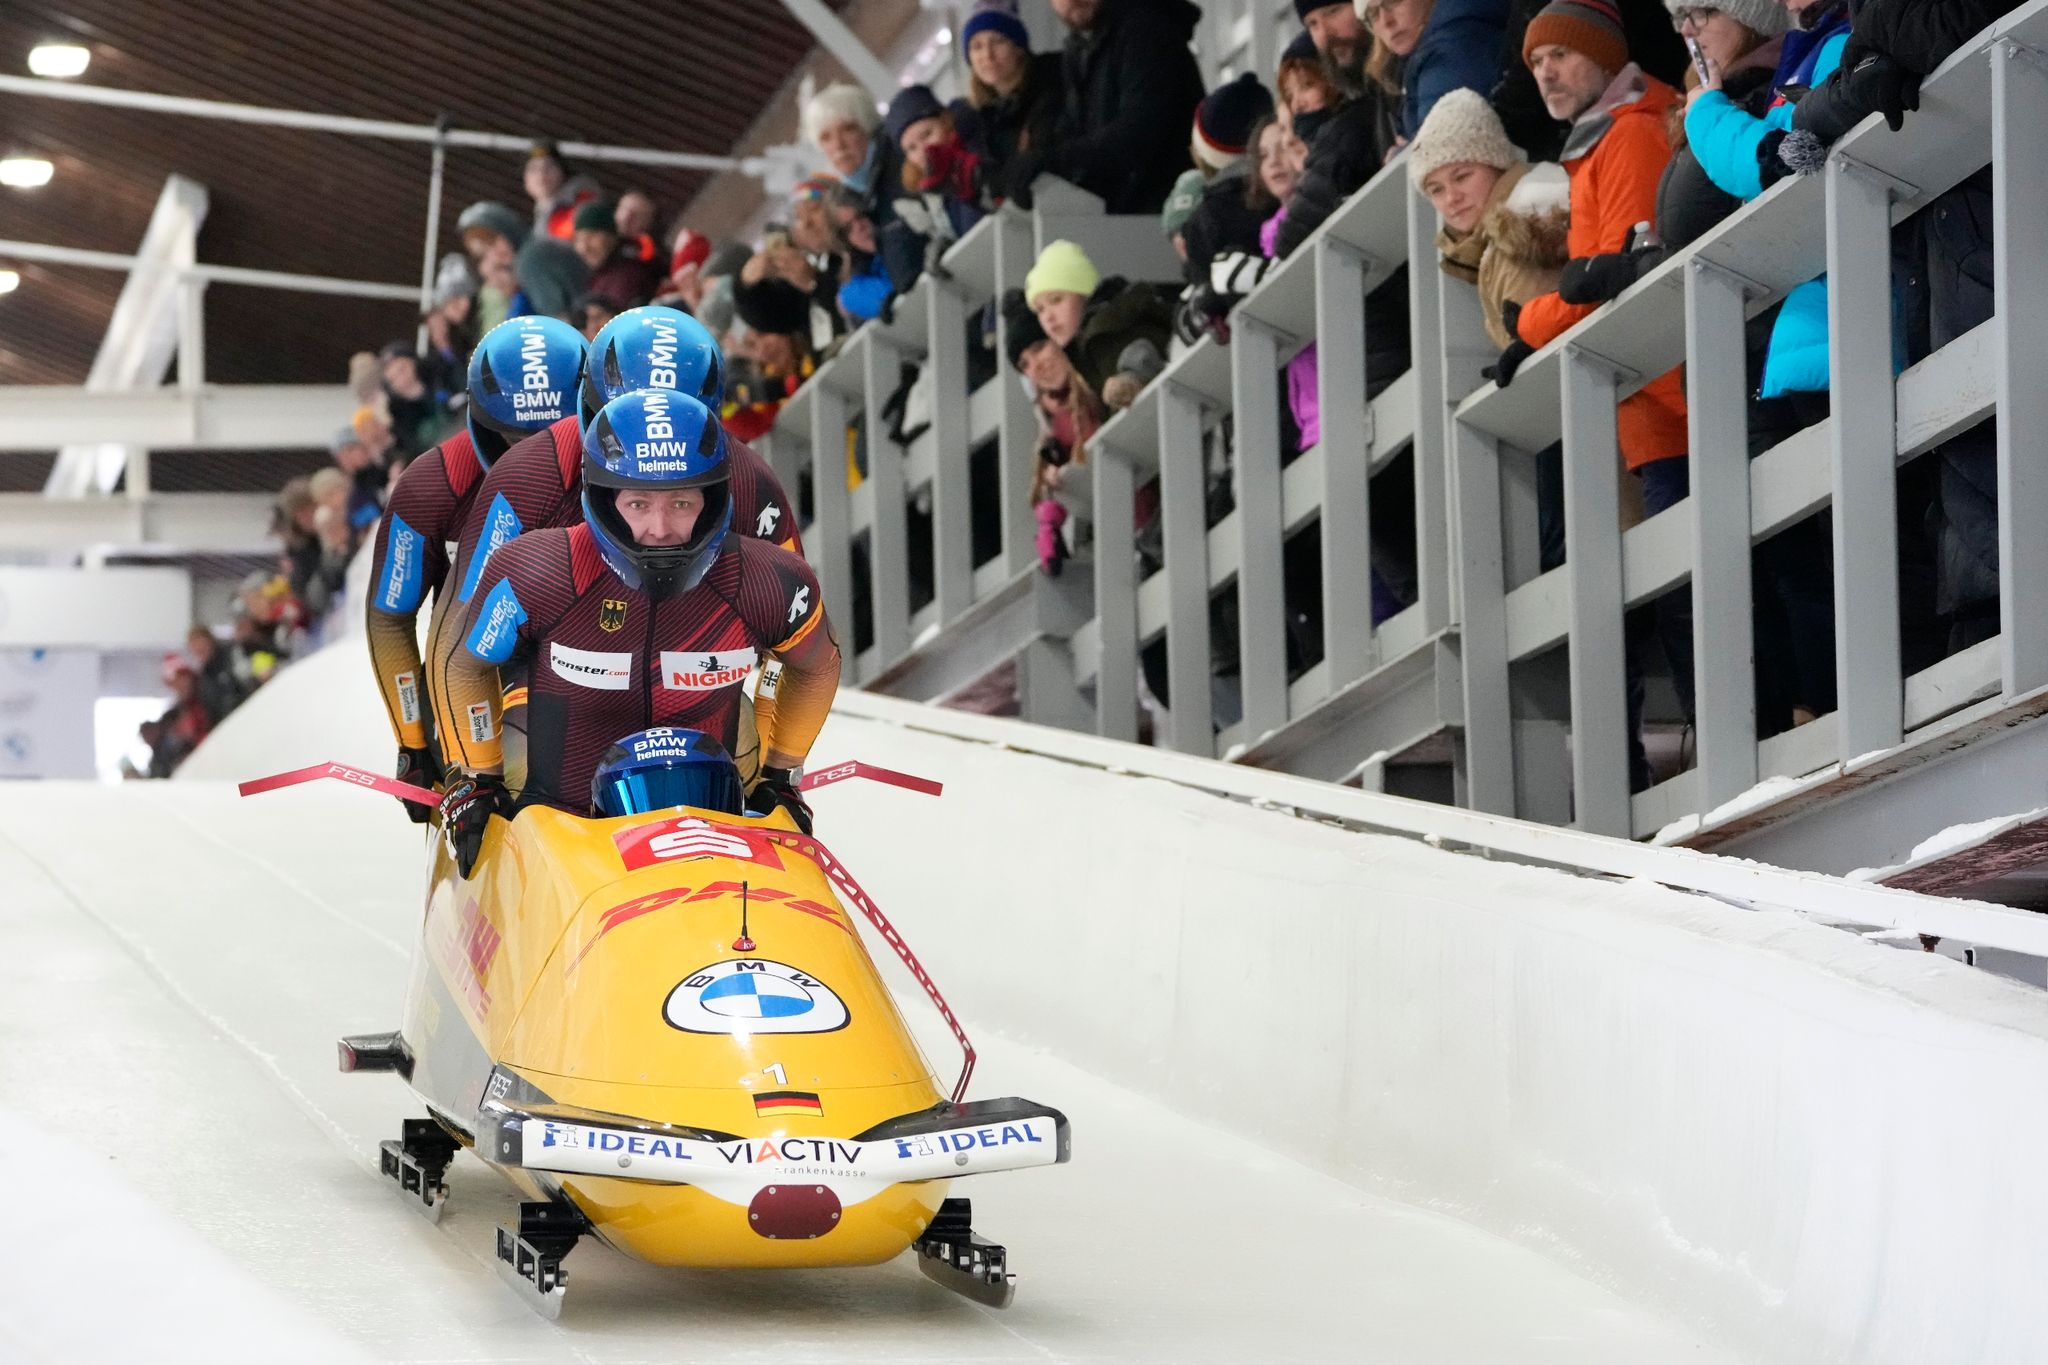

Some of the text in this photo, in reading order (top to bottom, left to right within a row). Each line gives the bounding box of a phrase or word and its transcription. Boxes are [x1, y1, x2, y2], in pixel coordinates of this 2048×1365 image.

[521, 333, 550, 390] BMW
[650, 324, 678, 389] BMW
[513, 391, 561, 408] BMW
[516, 408, 561, 421] helmets
[635, 442, 687, 458] BMW
[638, 459, 687, 473] helmets
[552, 655, 629, 677] fenster.com
[673, 664, 752, 687] NIGRIN
[633, 737, 687, 752] BMW
[636, 748, 688, 761] helmets
[328, 765, 376, 786] FES
[813, 764, 857, 786] FES
[684, 961, 825, 988] BMW
[762, 1063, 789, 1085] 1
[490, 1072, 512, 1099] FES
[588, 1130, 692, 1160] IDEAL
[938, 1122, 1042, 1153] IDEAL
[716, 1139, 862, 1164] VIACTIV
